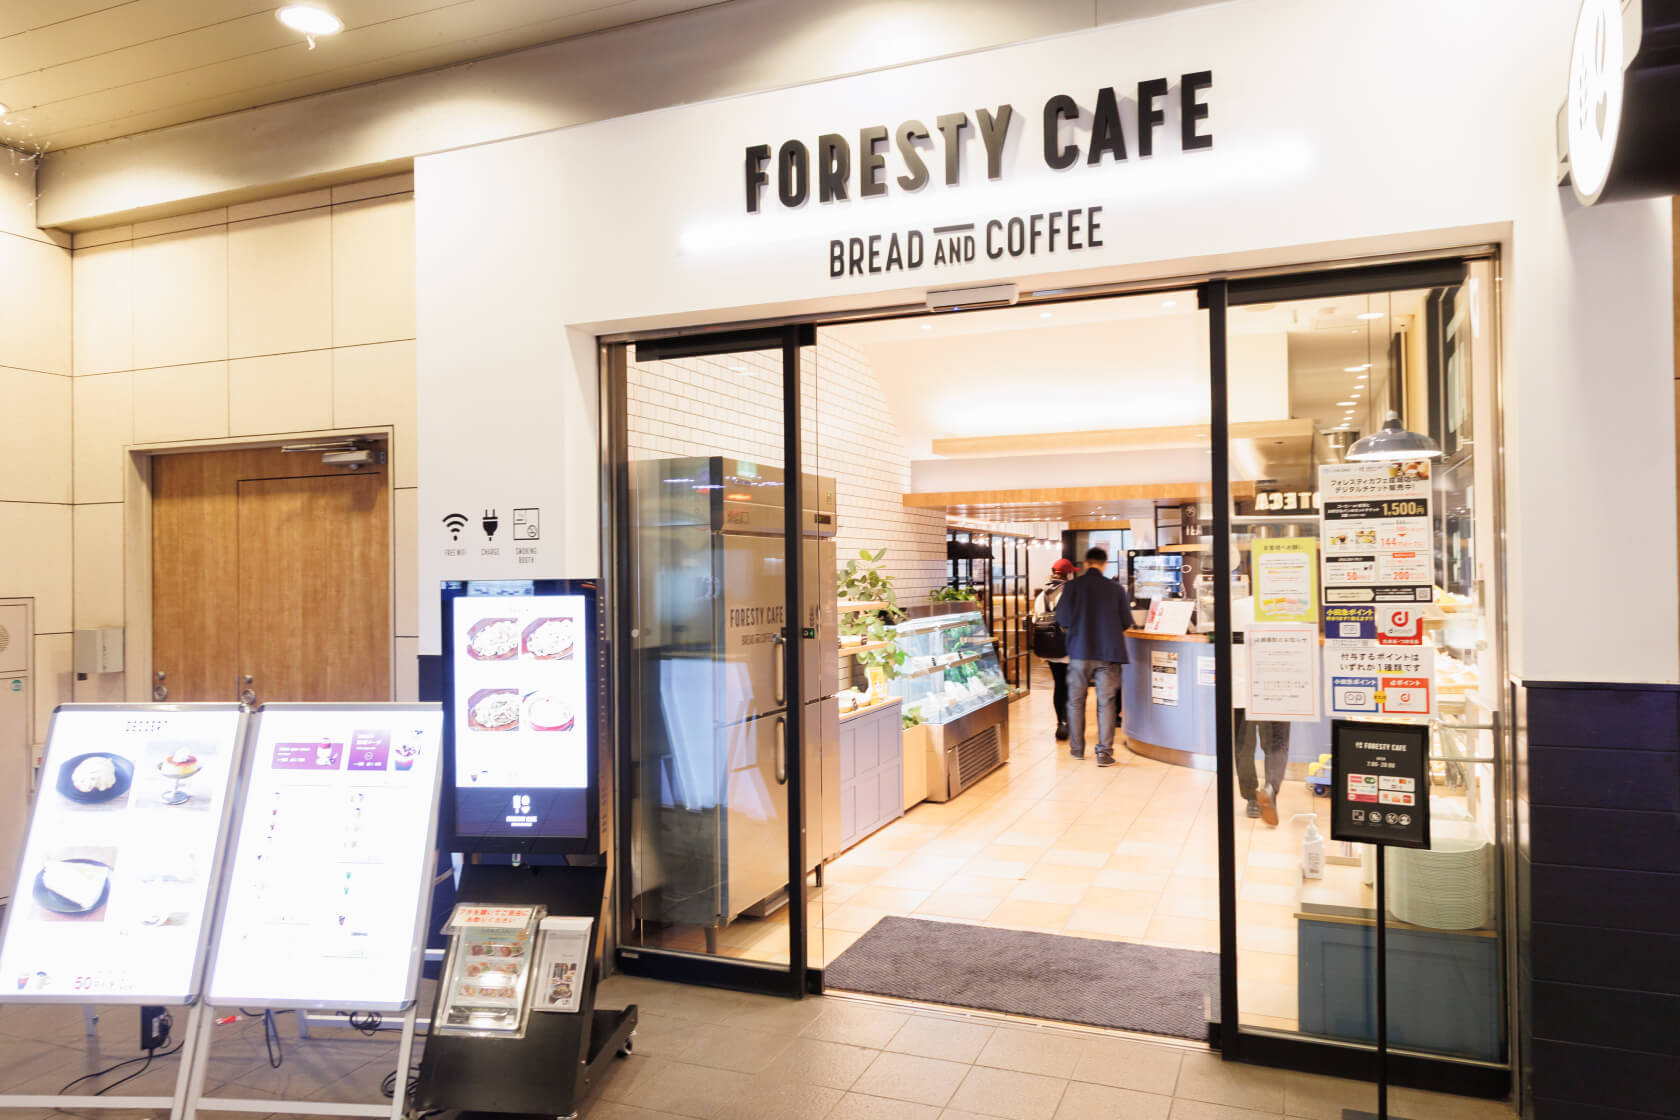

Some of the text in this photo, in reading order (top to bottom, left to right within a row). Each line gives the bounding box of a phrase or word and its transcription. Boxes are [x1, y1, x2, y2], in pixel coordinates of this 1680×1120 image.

[745, 70, 1213, 213] FORESTY CAFE
[829, 206, 1104, 278] BREAD AND COFFEE
[730, 606, 783, 627] FORESTY CAFE
[1340, 652, 1420, 662] 付与するポイントは
